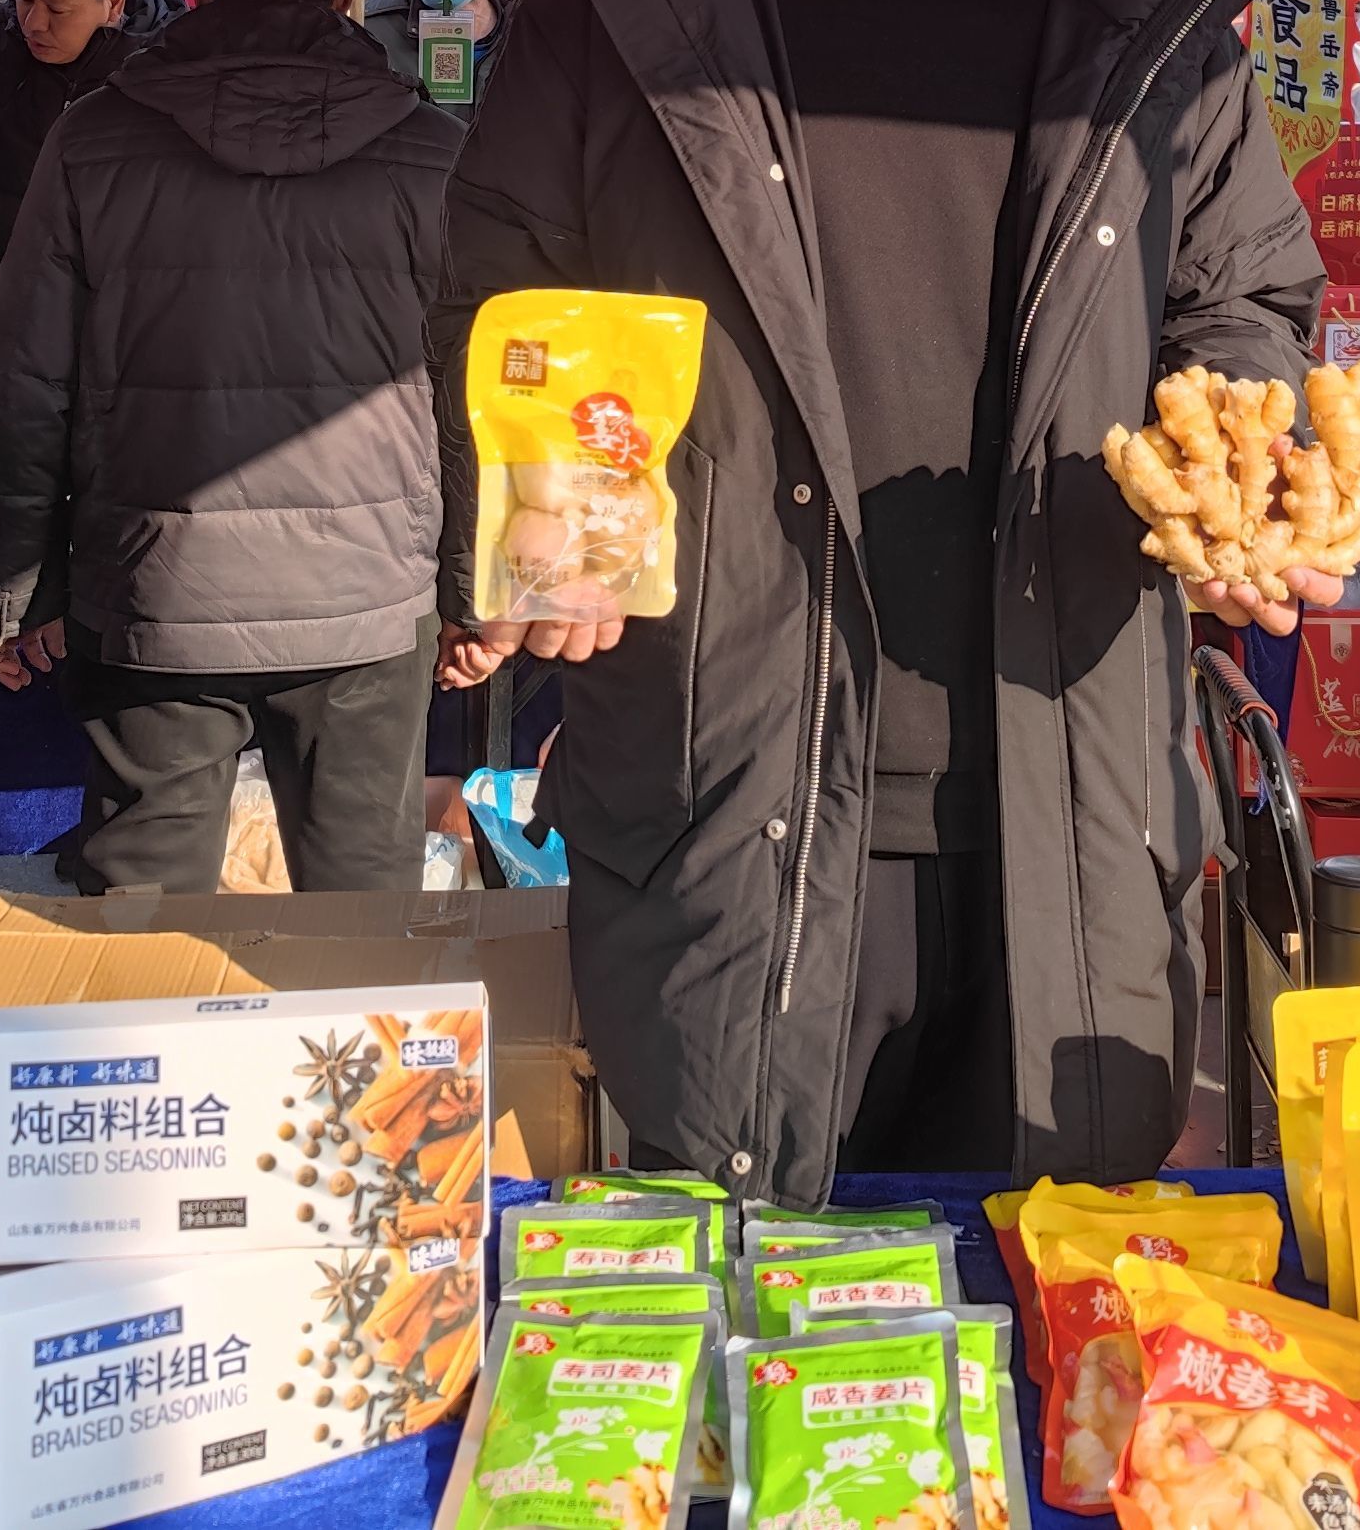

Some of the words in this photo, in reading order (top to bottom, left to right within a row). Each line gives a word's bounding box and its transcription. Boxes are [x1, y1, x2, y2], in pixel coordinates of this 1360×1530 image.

[10, 1092, 231, 1147] 炖卤料组合
[7, 1150, 99, 1178] BRAISED
[104, 1144, 227, 1175] SEASONING
[7, 1217, 141, 1238] 山东省万兴食品有限公司
[572, 1248, 677, 1267] 寿司姜片
[817, 1284, 924, 1304] 咸香姜片
[33, 1333, 252, 1426] 炖卤料组合
[562, 1362, 674, 1383] 寿司姜片
[1173, 1339, 1333, 1420] 嫩姜芽
[810, 1380, 927, 1408] 咸香姜片
[30, 1413, 124, 1458] BRAISED
[129, 1383, 248, 1435] SEASONING
